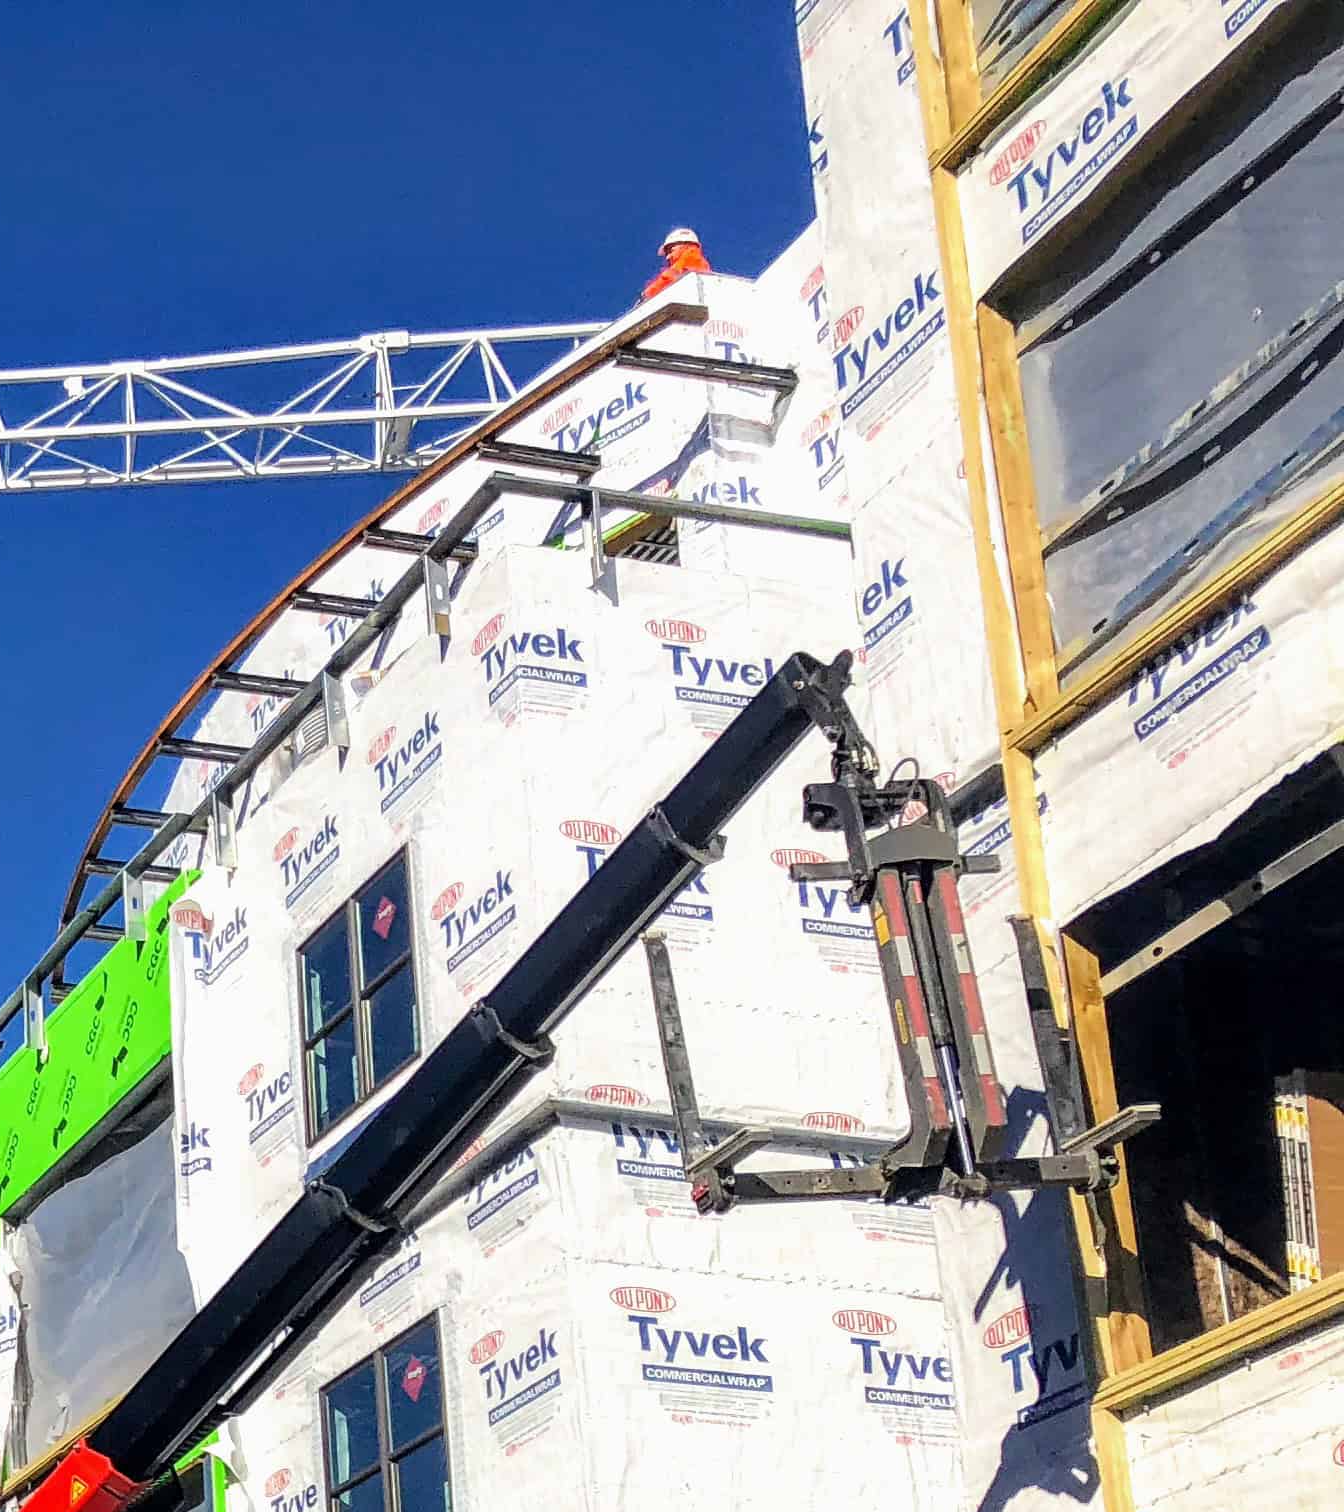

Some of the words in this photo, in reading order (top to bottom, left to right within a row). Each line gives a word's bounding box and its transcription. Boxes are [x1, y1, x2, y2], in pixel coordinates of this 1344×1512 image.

[1007, 77, 1133, 213] Tyvek
[833, 271, 940, 390] Tyvek
[481, 629, 585, 683] Tyvek
[1138, 630, 1266, 737] COMMERCIALWRAP
[374, 711, 440, 792] Tyvek
[280, 814, 338, 887] Tyvek
[440, 870, 513, 950] Tyvek
[85, 1019, 100, 1056] CGC
[121, 1001, 138, 1042] CGC
[62, 1075, 77, 1115] CGC
[246, 1069, 291, 1122] Tyve
[3, 1133, 18, 1170] CGC
[480, 1329, 558, 1400] Tyvek
[628, 1315, 768, 1365] Tyvek
[851, 1338, 953, 1385] Tyve
[645, 1367, 769, 1389] COMMERCIALWRAP
